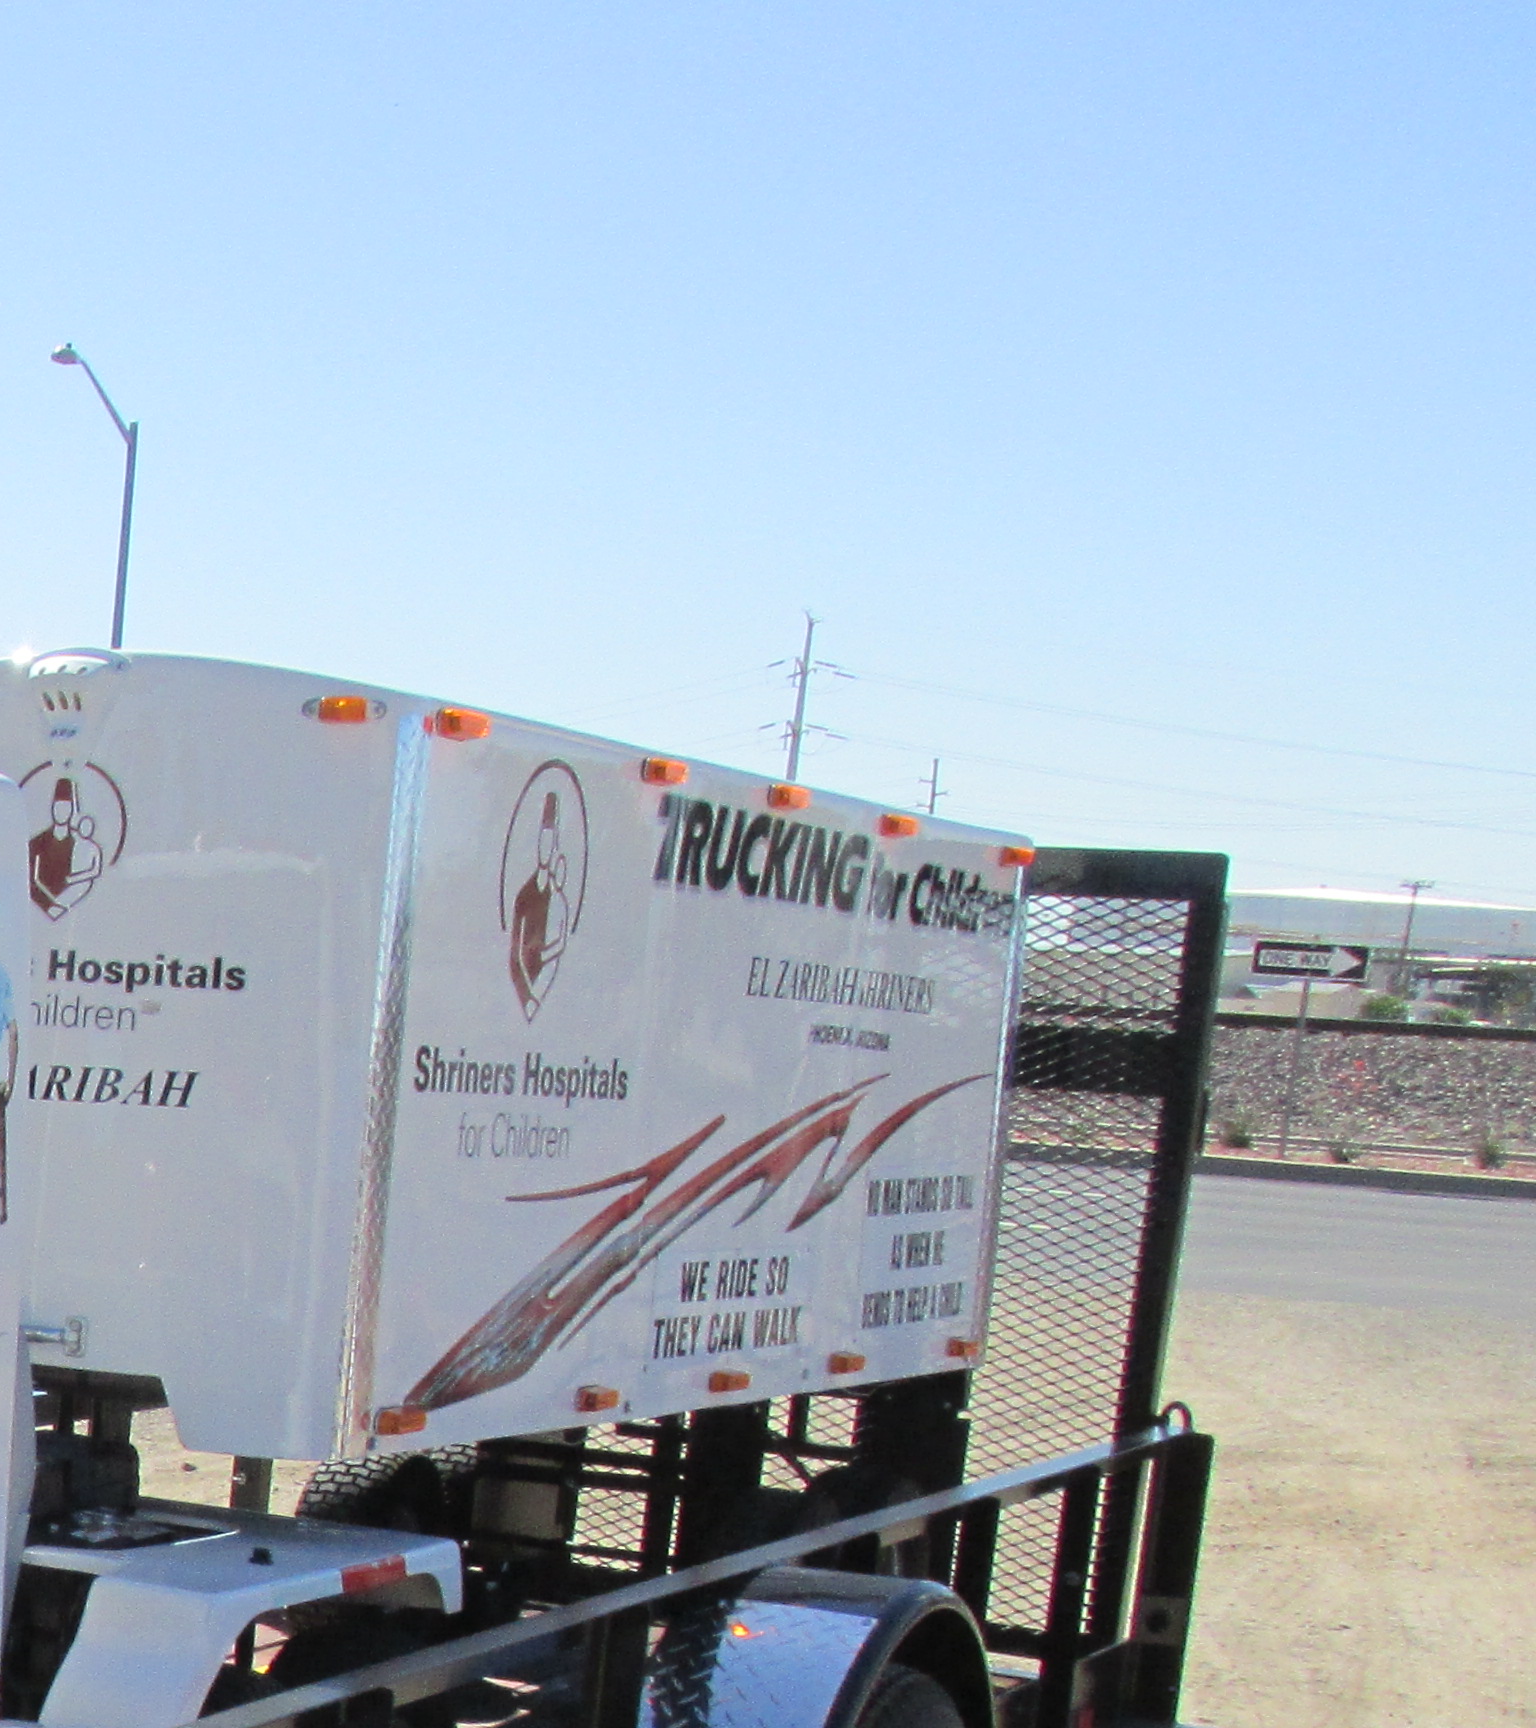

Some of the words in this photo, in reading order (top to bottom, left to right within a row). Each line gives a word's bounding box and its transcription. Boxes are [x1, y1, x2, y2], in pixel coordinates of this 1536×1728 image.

[652, 791, 870, 914] TRUCKING
[47, 948, 246, 993] Hospitals
[746, 956, 771, 998] EL
[1262, 950, 1294, 967] ONE
[1299, 952, 1333, 969] WAY
[413, 1045, 516, 1096] Shriners
[522, 1051, 629, 1108] Hospitals
[458, 1111, 486, 1159] for
[491, 1112, 571, 1160] Children
[680, 1260, 711, 1303] WE
[716, 1258, 759, 1300] RIDE
[765, 1256, 791, 1297] SO
[652, 1315, 702, 1360] THEY
[707, 1311, 747, 1355] CAN
[752, 1305, 803, 1349] WALK
